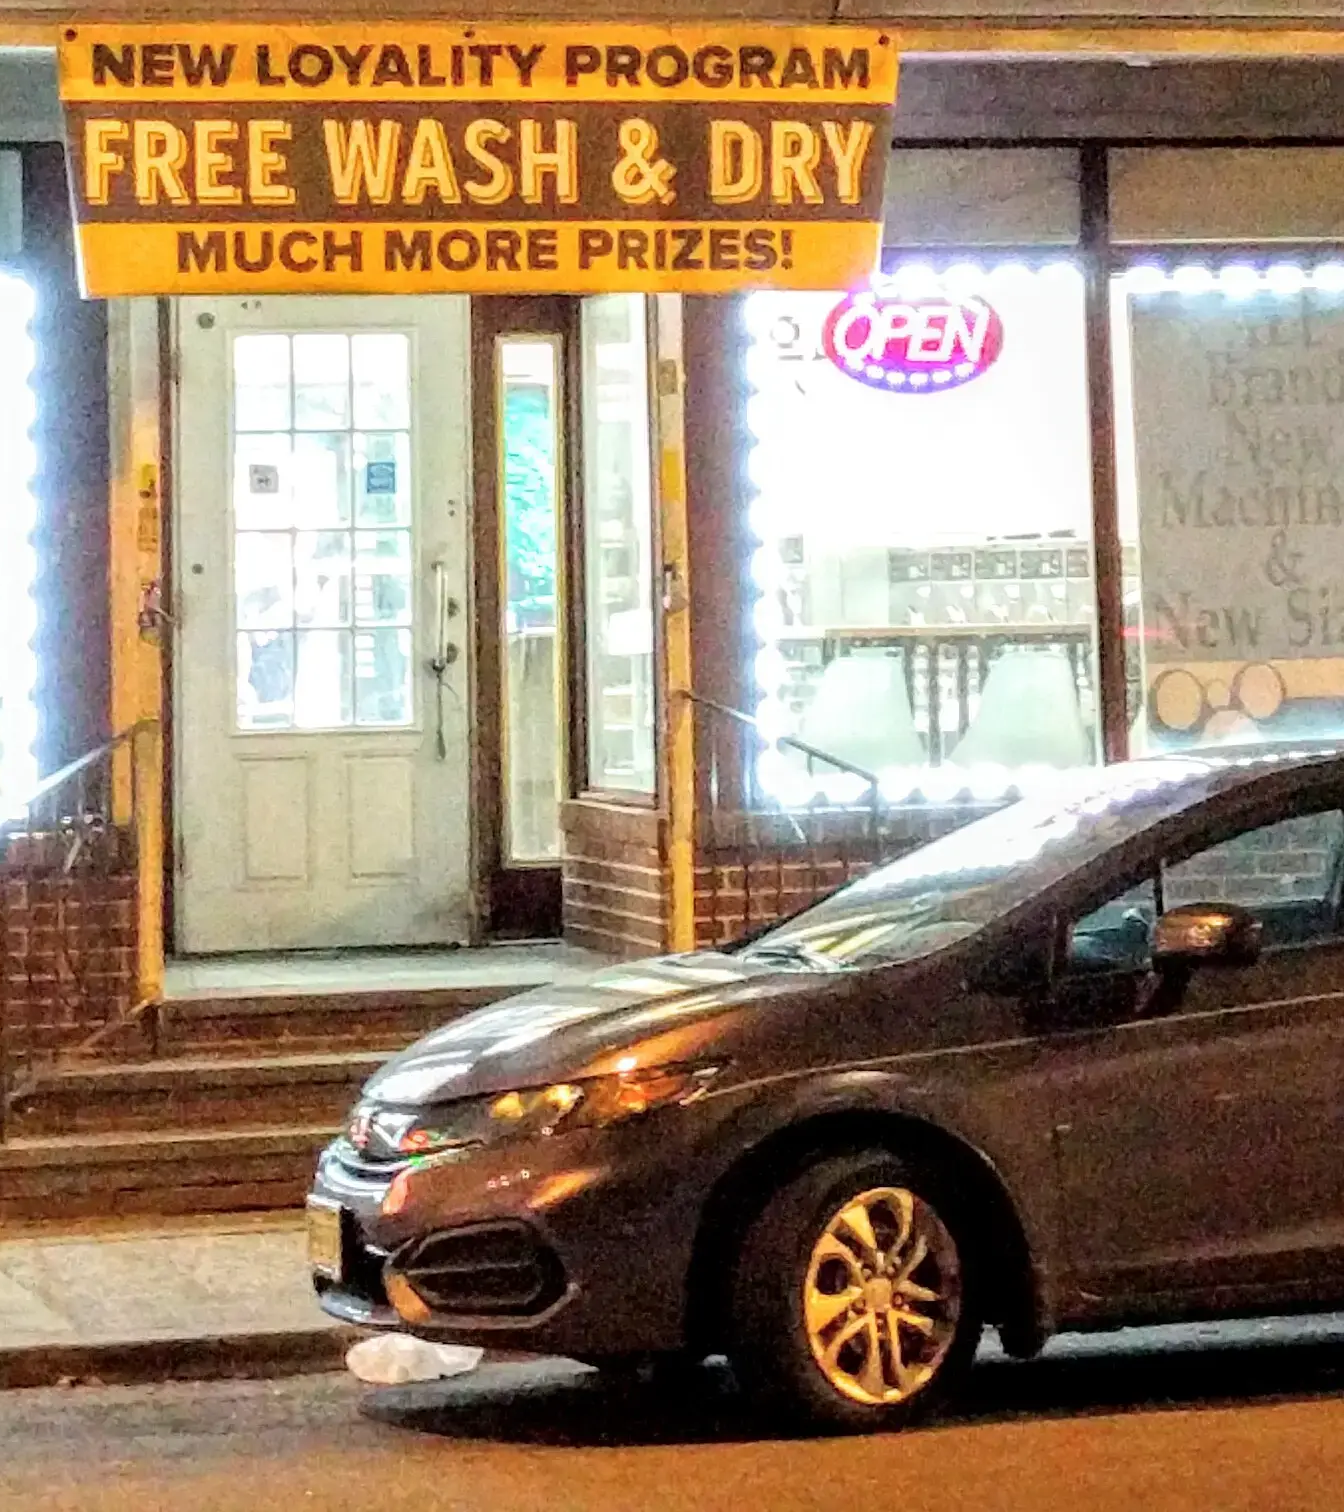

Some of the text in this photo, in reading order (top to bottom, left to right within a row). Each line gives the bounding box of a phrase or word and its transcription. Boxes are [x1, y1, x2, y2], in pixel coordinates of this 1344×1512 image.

[91, 43, 872, 90] NEW LOYALITY PROGRAM
[84, 117, 874, 206] FREE WASH & DRY
[176, 228, 795, 274] MUCH MORE PRIZES!
[831, 302, 991, 364] OPEN
[1264, 530, 1305, 587] &
[1152, 589, 1263, 650] New
